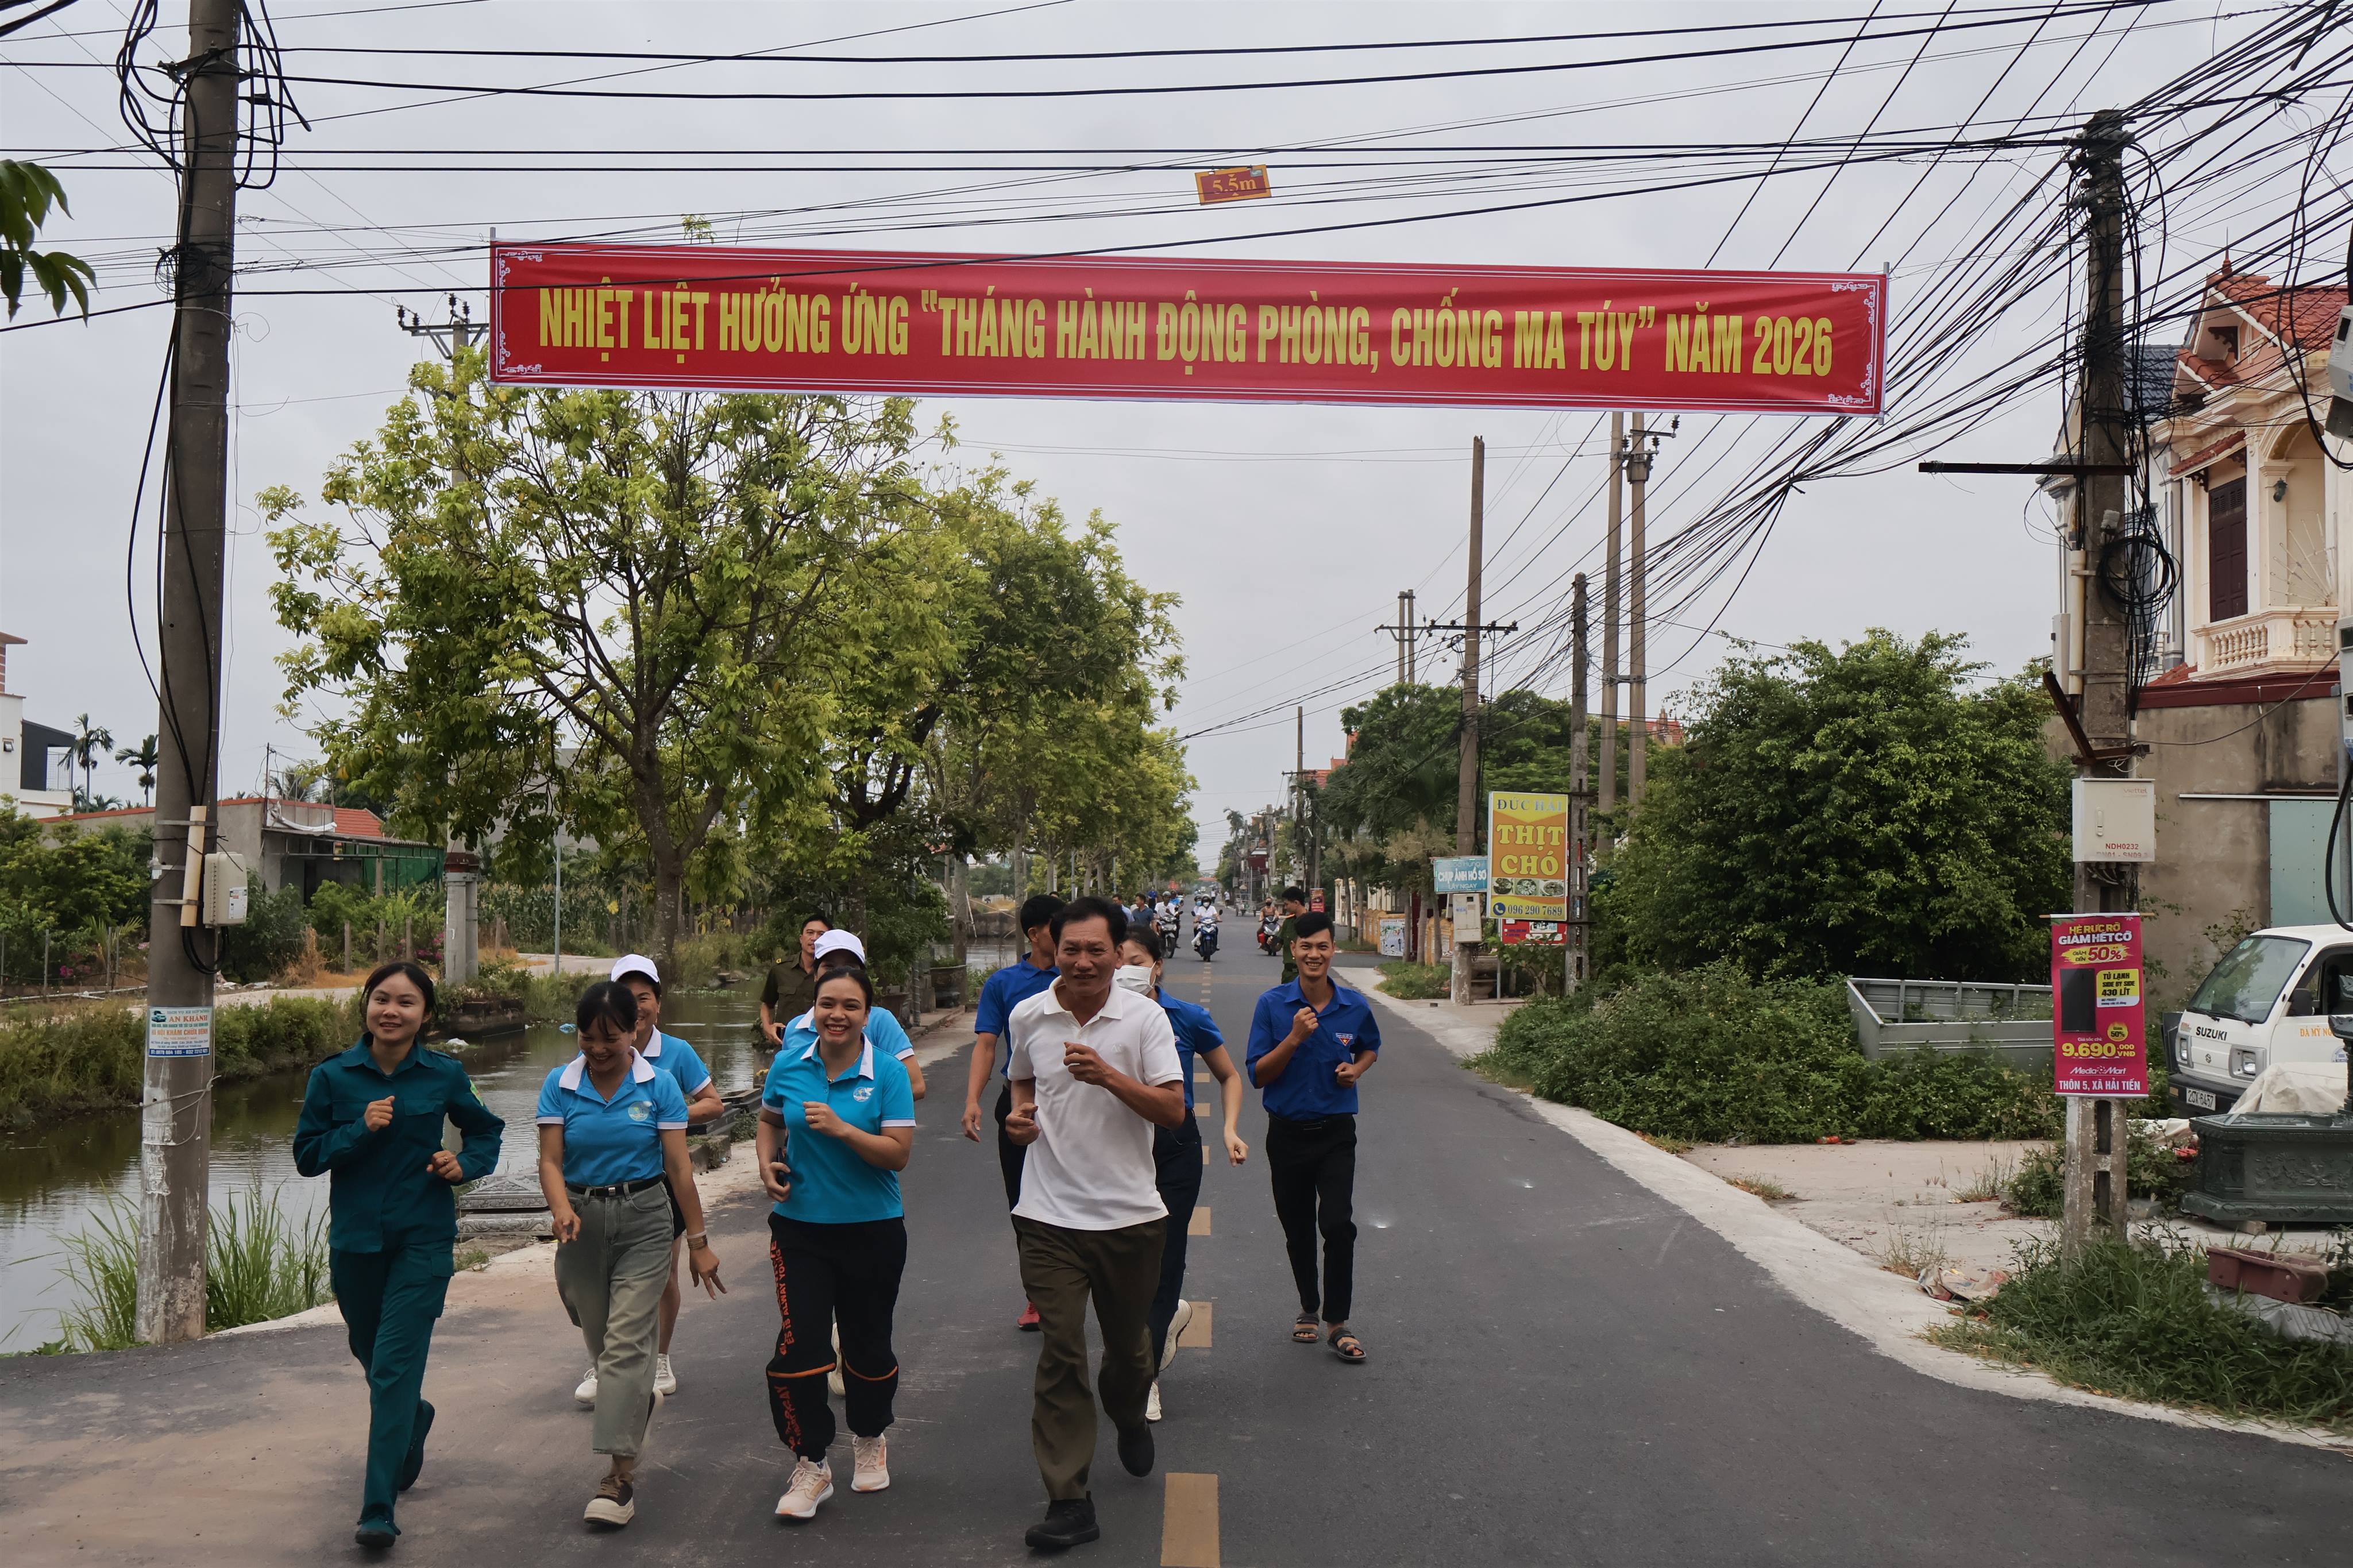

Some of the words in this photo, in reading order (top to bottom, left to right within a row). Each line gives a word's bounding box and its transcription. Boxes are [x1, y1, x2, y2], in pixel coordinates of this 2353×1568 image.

[1213, 177, 1257, 194] 5.5m
[539, 277, 633, 362] NHIỆT
[643, 278, 709, 364] LIỆT
[720, 274, 830, 354] HƯỞNG
[842, 282, 908, 356] ỨNG
[1057, 288, 1147, 360] HÀNH
[1156, 289, 1247, 375] ĐỘNG
[1257, 291, 1379, 373] PHÒNG,
[1391, 287, 1503, 369] CHỐNG
[1514, 311, 1567, 370] MA
[1665, 302, 1743, 374] NĂM
[1753, 316, 1833, 377] 2026
[1497, 797, 1529, 810] ĐỨC
[1496, 824, 1564, 851] THỊT
[1500, 850, 1559, 875] CHÓ
[1507, 905, 1522, 914] 096
[1525, 905, 1540, 915] 290
[1542, 906, 1563, 916] 7689
[2069, 925, 2082, 934] HÈ
[2088, 947, 2122, 961] 50%
[2103, 972, 2111, 980] TỦ
[2119, 987, 2130, 995] LÍT
[2196, 1026, 2227, 1041] SUZUKI
[2061, 1042, 2116, 1057] 9.690
[2070, 1066, 2097, 1074] Media
[2059, 1079, 2080, 1090] THÔN
[2082, 1081, 2090, 1091] 5,
[2092, 1079, 2103, 1090] XÃ
[2105, 1077, 2119, 1090] HẢI
[2121, 1078, 2140, 1090] TIẾN
